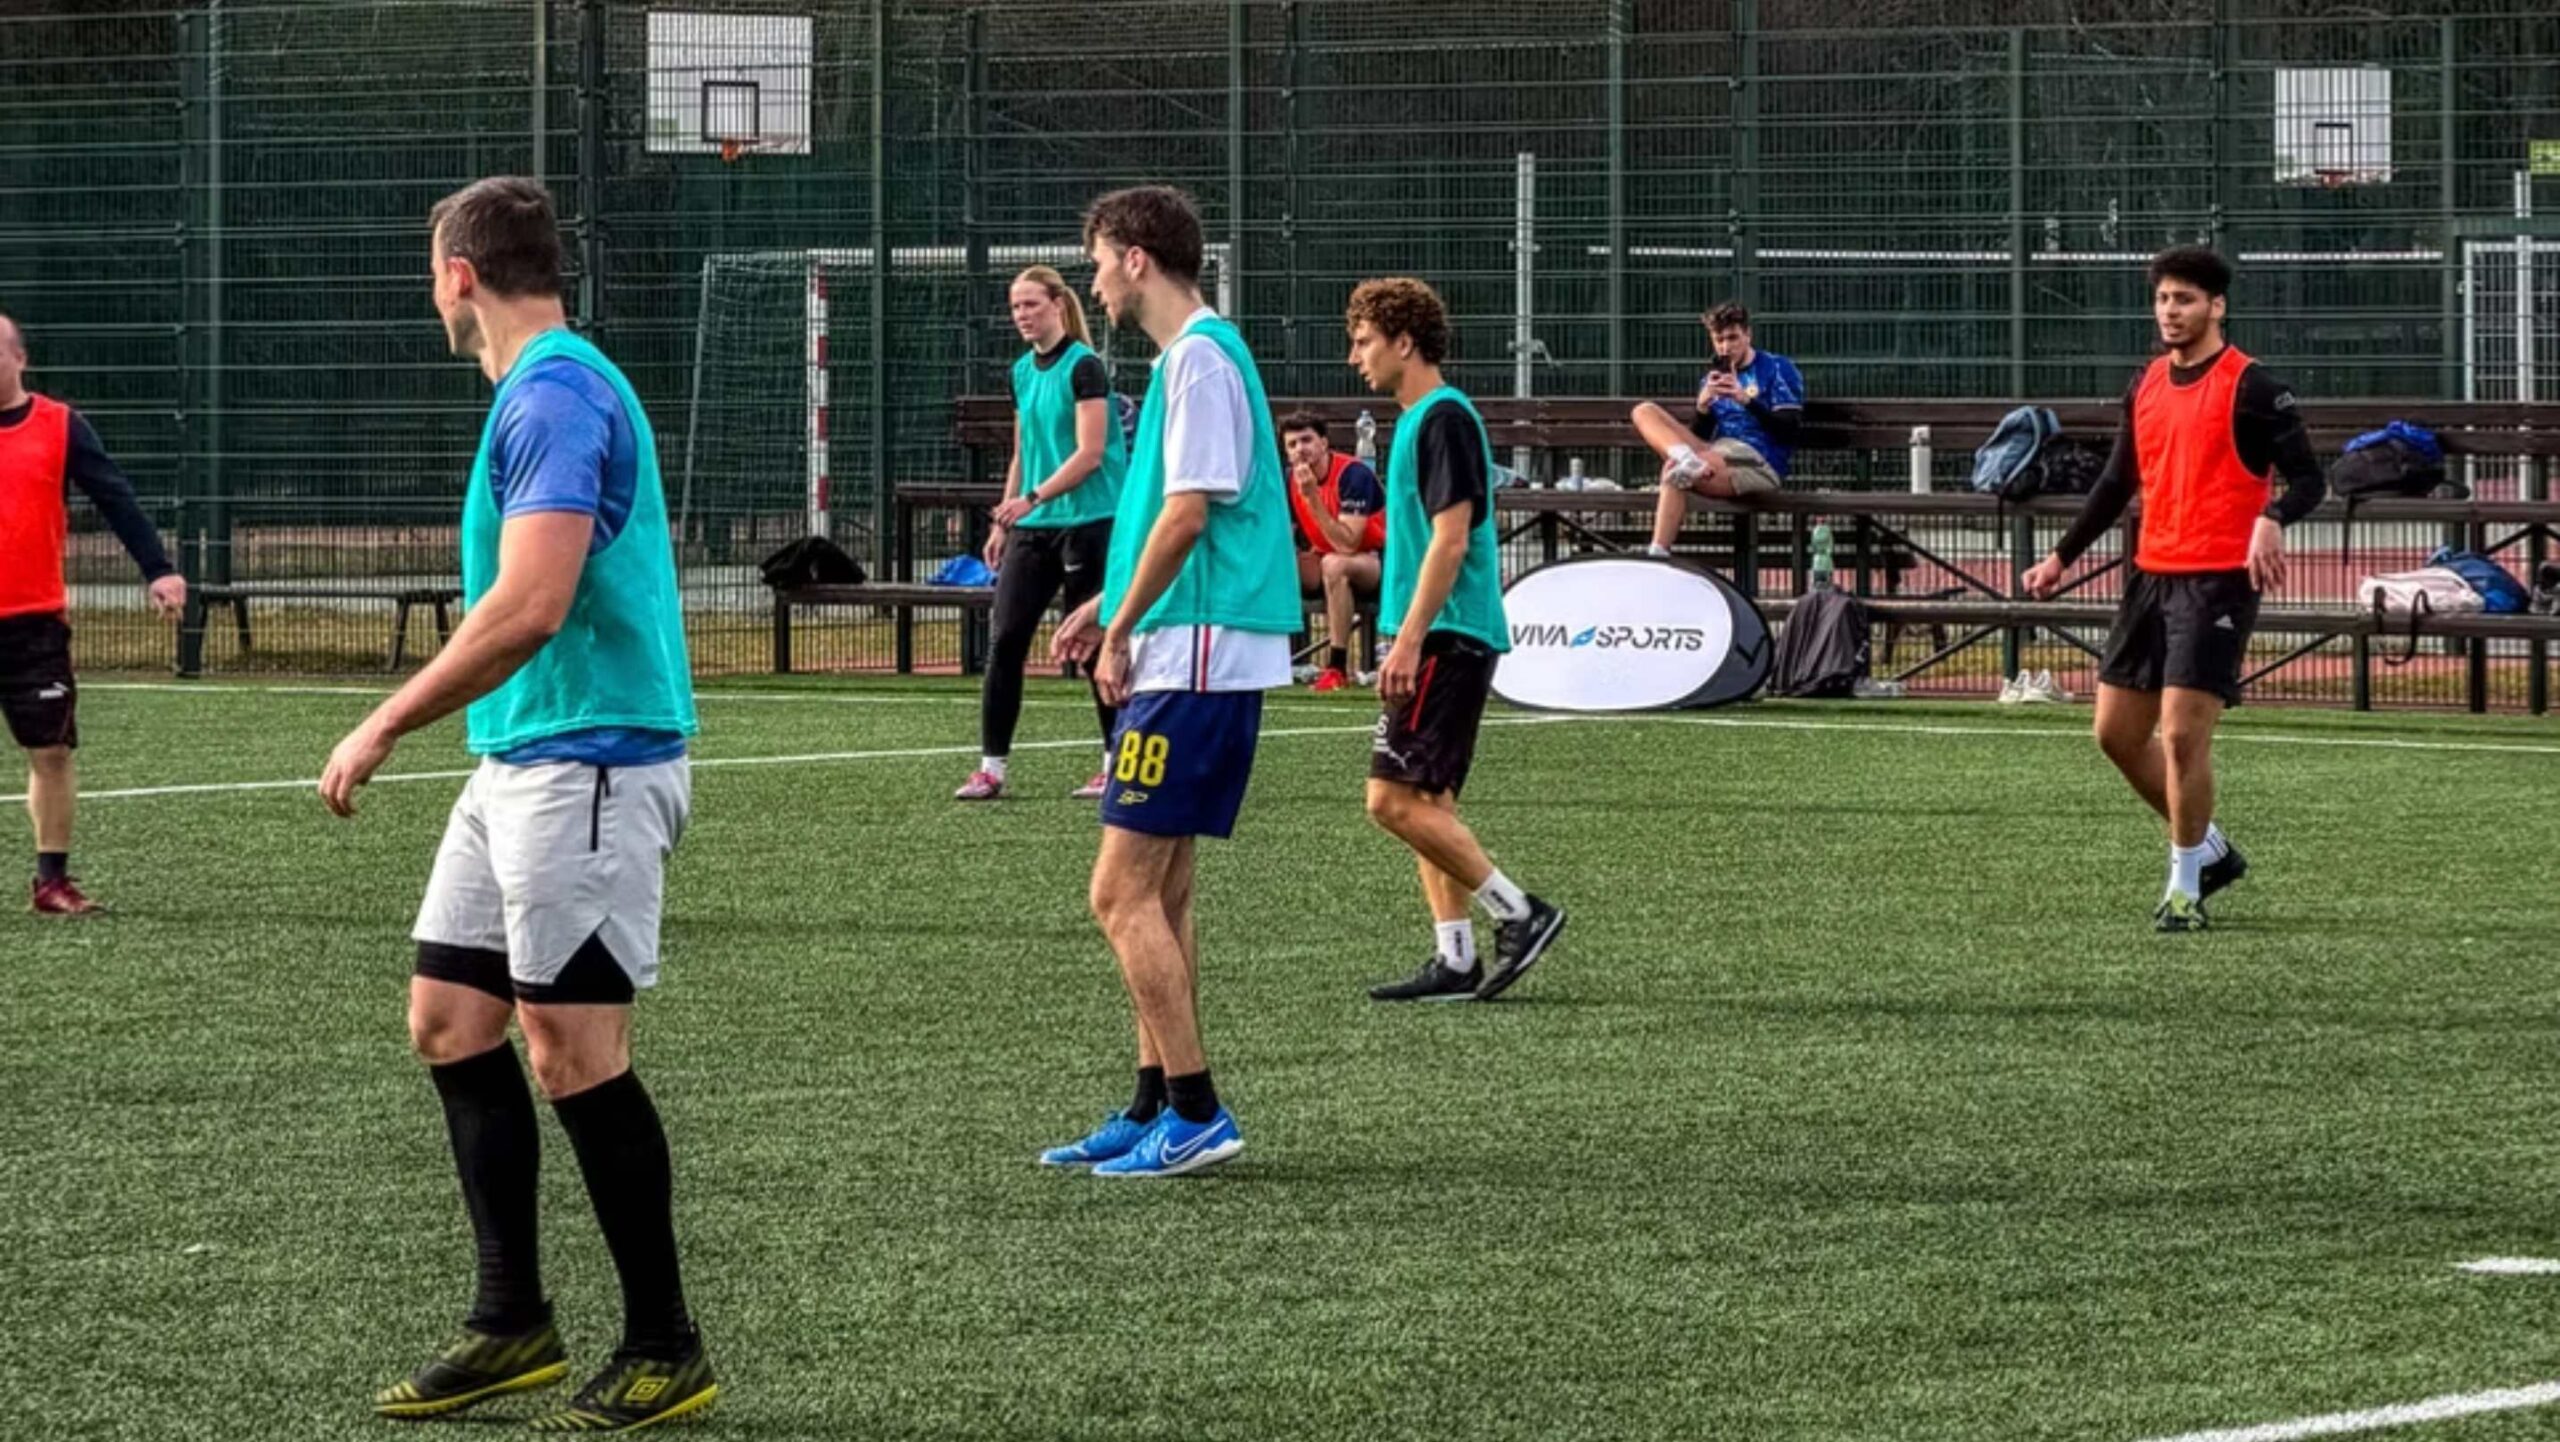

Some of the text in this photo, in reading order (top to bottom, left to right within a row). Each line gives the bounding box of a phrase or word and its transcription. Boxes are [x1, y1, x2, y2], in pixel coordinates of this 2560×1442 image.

[1512, 624, 1704, 651] VIVA SPORTS
[1116, 730, 1169, 787] 88
